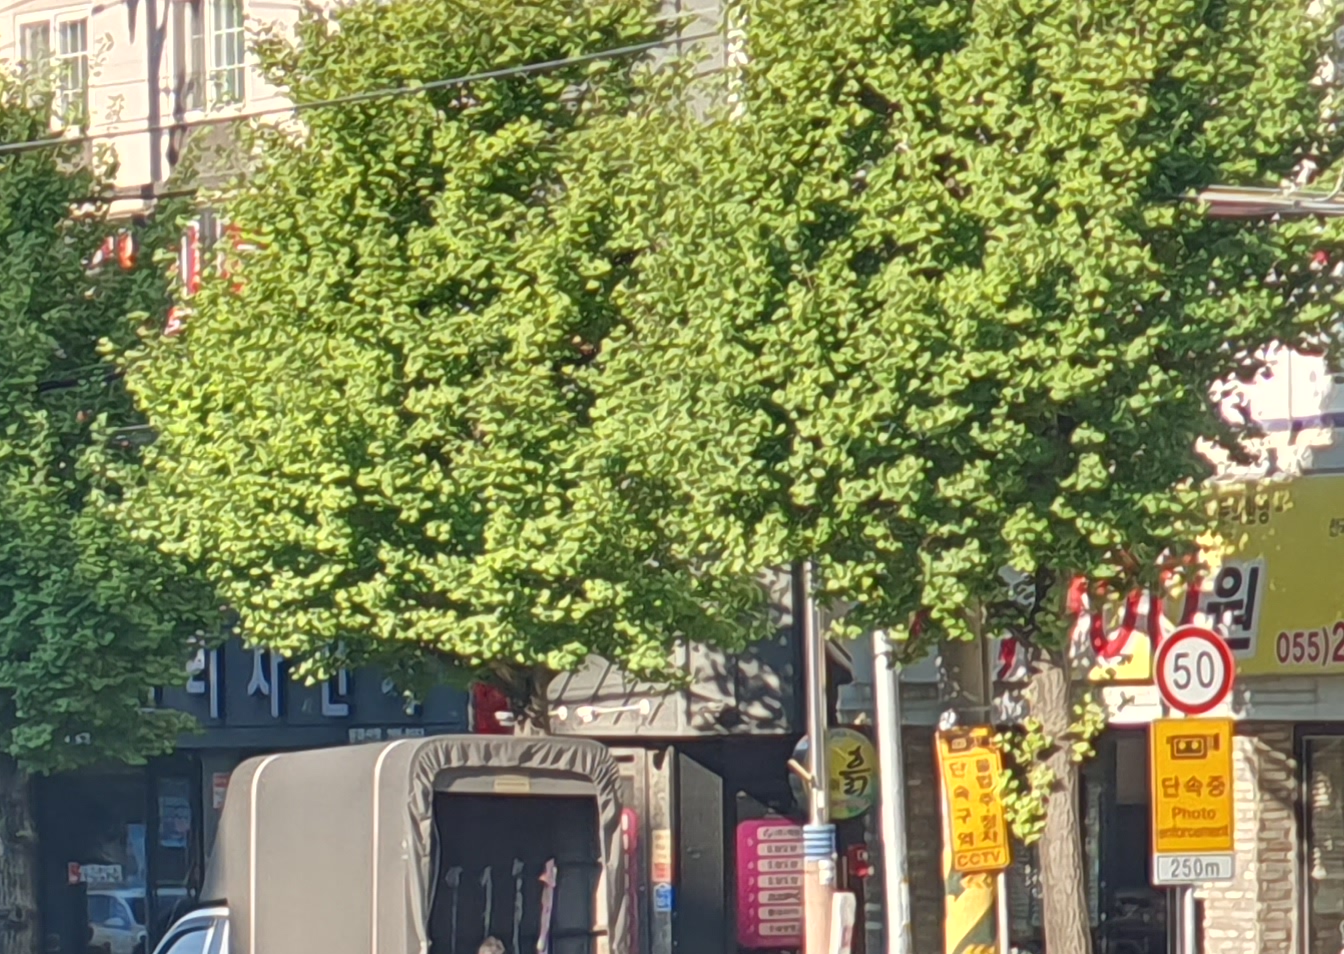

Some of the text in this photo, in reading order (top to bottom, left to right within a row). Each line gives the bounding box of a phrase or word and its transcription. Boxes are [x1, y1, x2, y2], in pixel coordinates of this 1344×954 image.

[1172, 650, 1215, 690] 50
[1161, 774, 1227, 799] 단속중
[948, 761, 975, 847] 단속구역
[1171, 805, 1217, 822] Photo
[957, 849, 1002, 867] CCTV
[1170, 857, 1220, 879] 250m
